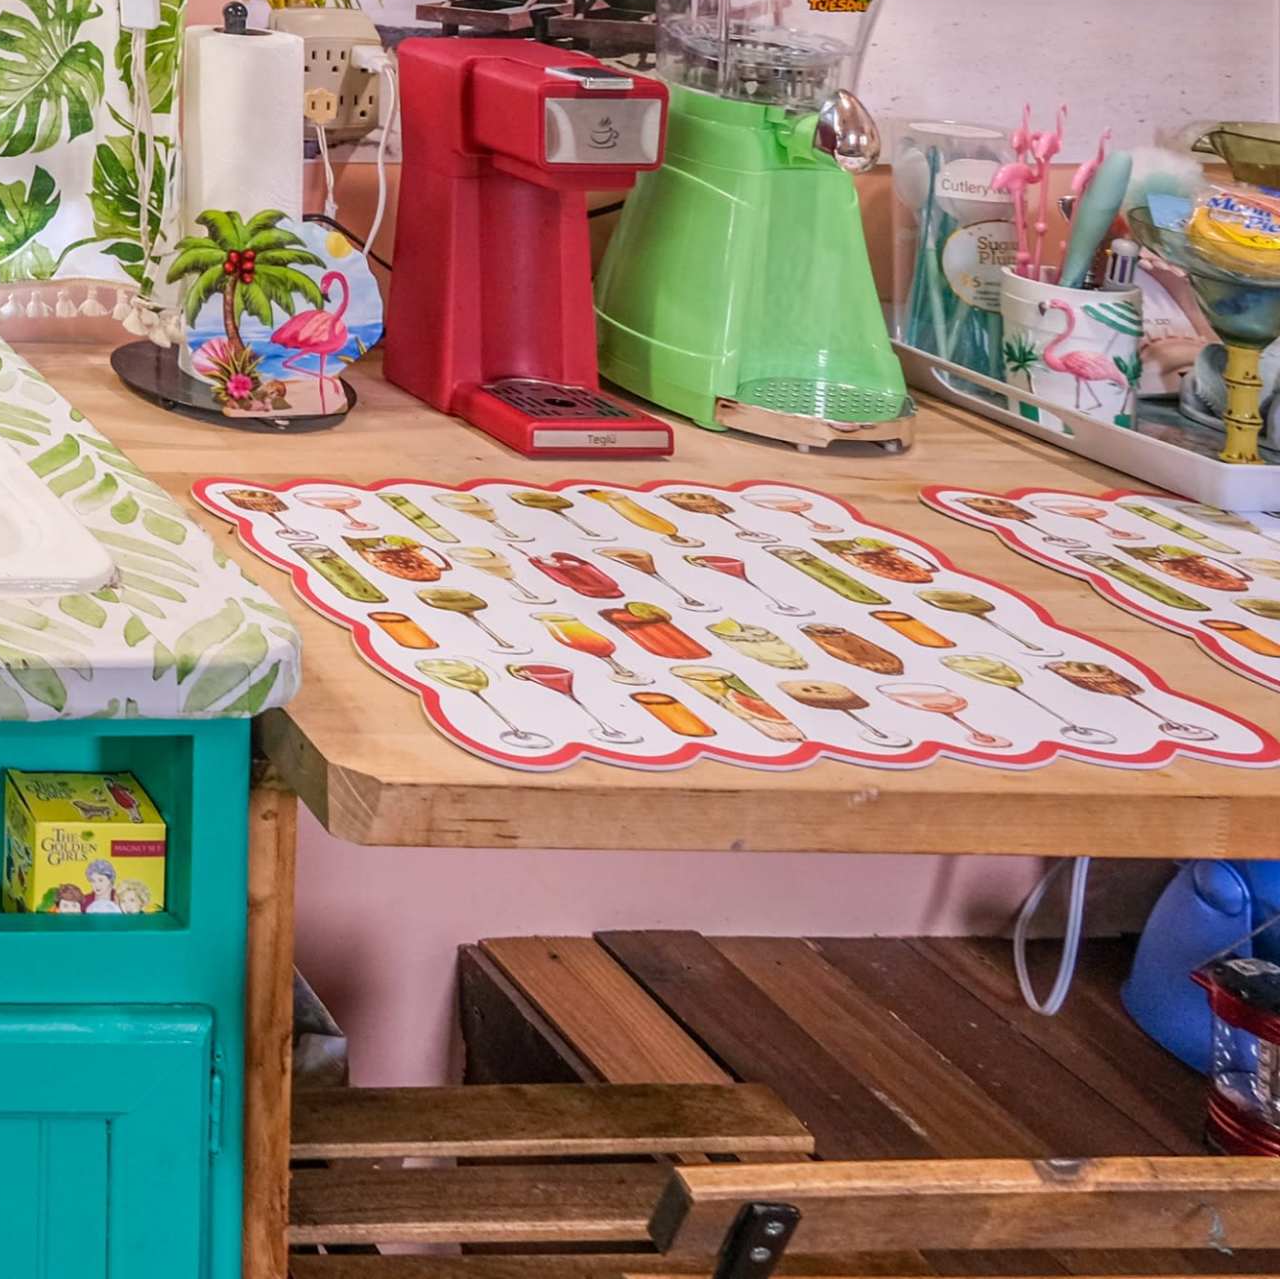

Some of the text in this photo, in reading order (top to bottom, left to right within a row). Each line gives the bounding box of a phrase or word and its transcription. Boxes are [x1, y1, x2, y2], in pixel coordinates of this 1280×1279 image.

[941, 178, 989, 196] Cutlery
[977, 235, 1019, 254] Suga
[52, 827, 78, 842] THE
[47, 850, 88, 866] GIRLS
